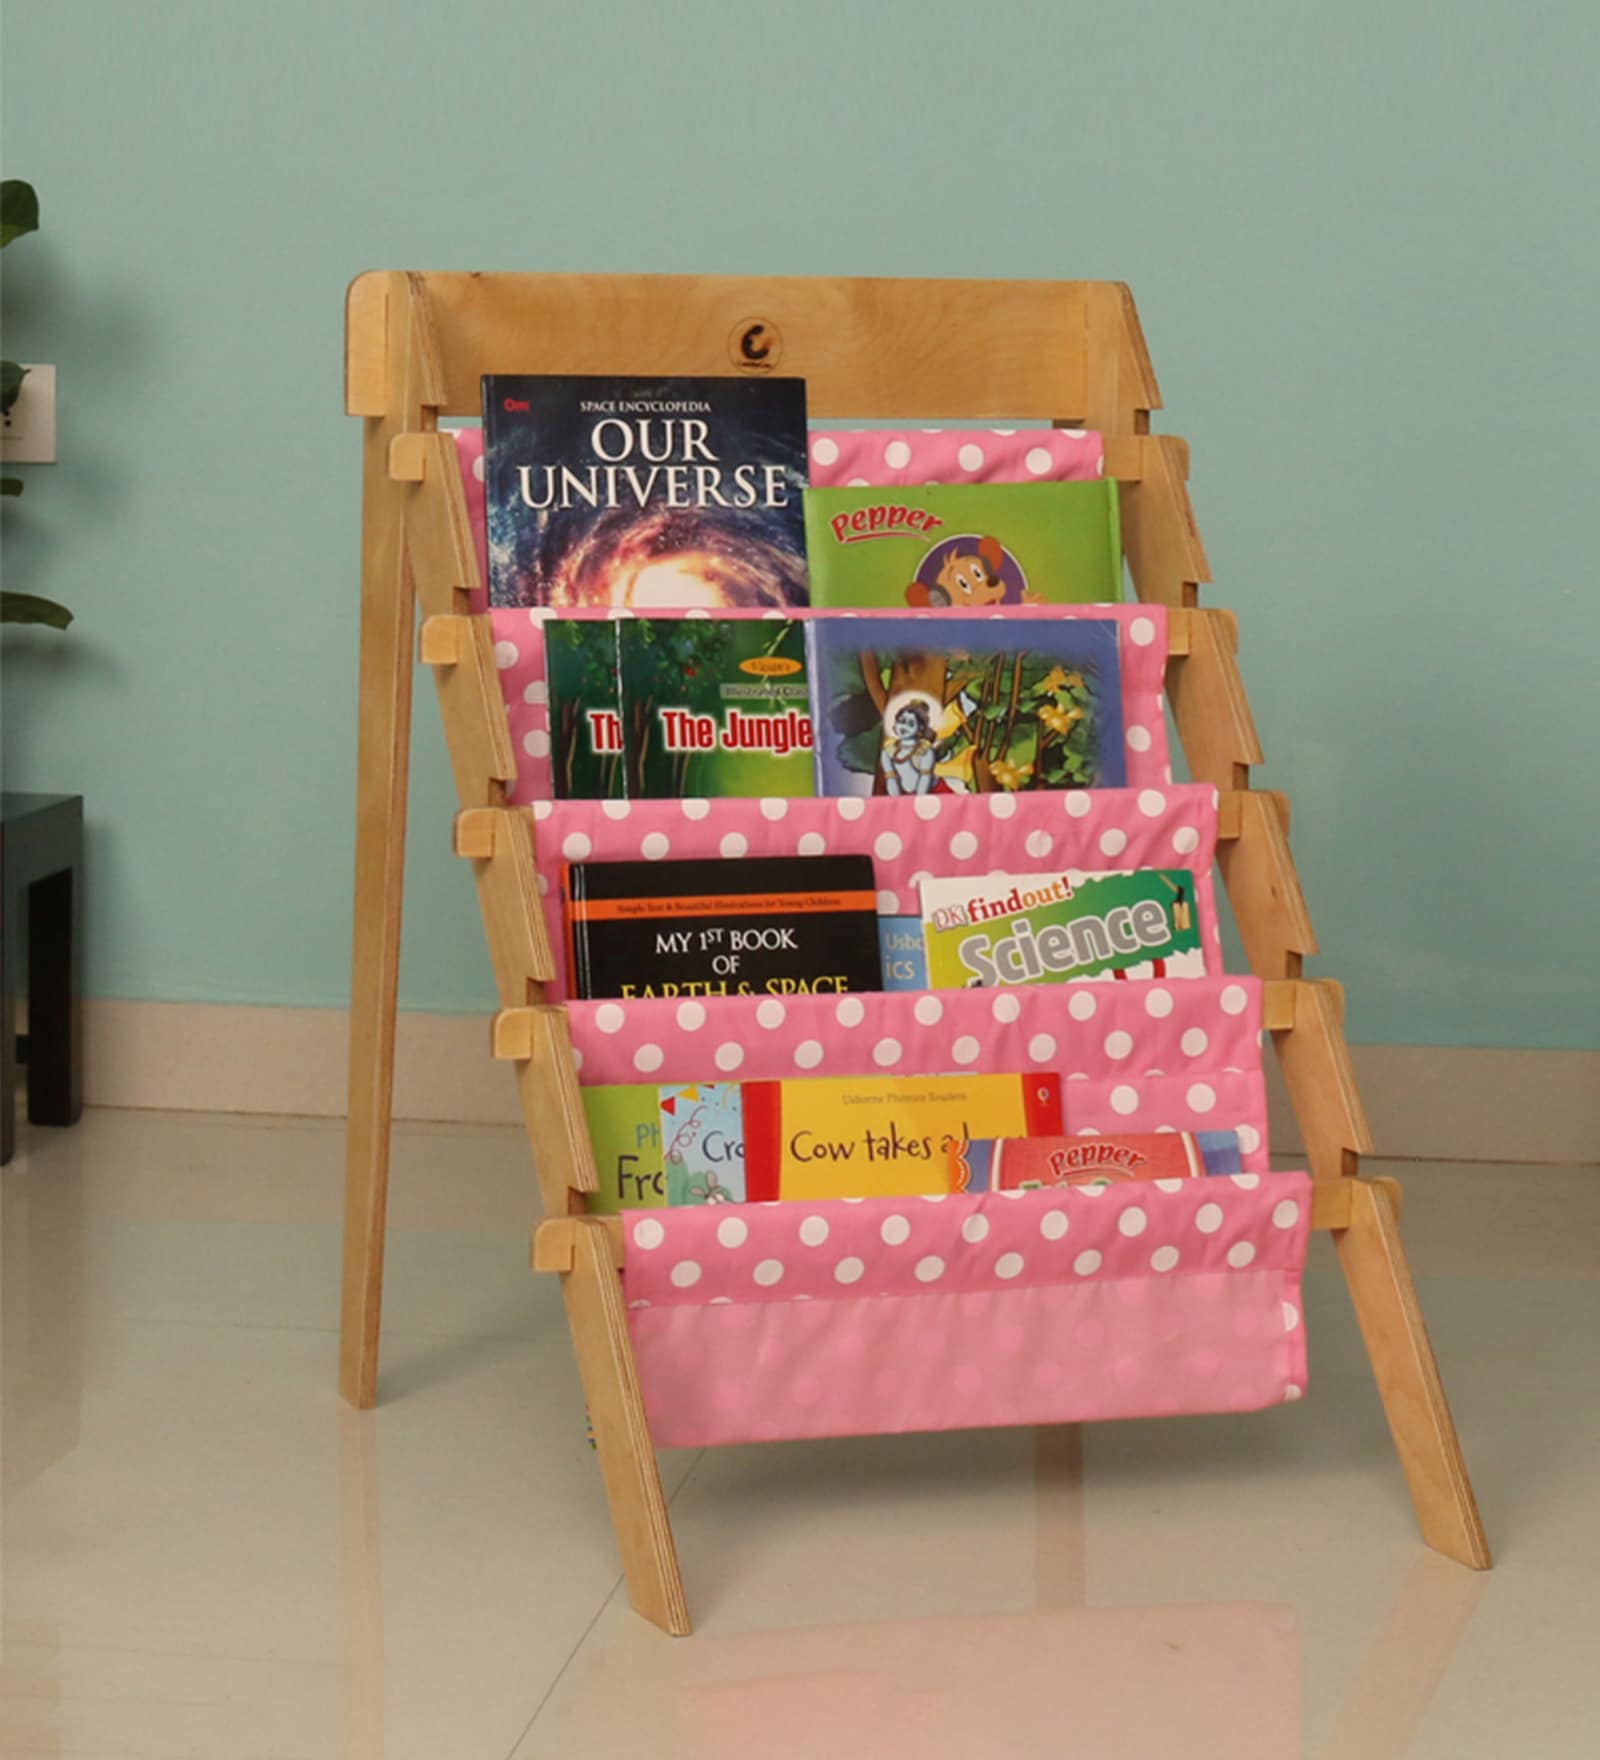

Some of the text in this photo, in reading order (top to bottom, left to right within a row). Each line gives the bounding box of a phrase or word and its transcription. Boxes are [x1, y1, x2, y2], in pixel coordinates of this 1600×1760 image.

[580, 401, 711, 413] SPACE ENCYCLOPEDIA
[591, 418, 719, 462] OUR
[516, 465, 789, 509] UNIVERSE
[831, 504, 943, 543] Pepper
[660, 710, 814, 754] The Jungle
[967, 877, 1074, 923] findout!
[656, 933, 693, 954] MY
[730, 928, 798, 951] BOOK
[959, 899, 1172, 988] Science
[712, 955, 741, 976] OF
[621, 975, 848, 999] EARTH & SPACE
[790, 1130, 855, 1163] Cow
[863, 1121, 932, 1161] takes
[1050, 1143, 1145, 1176] Pepper
